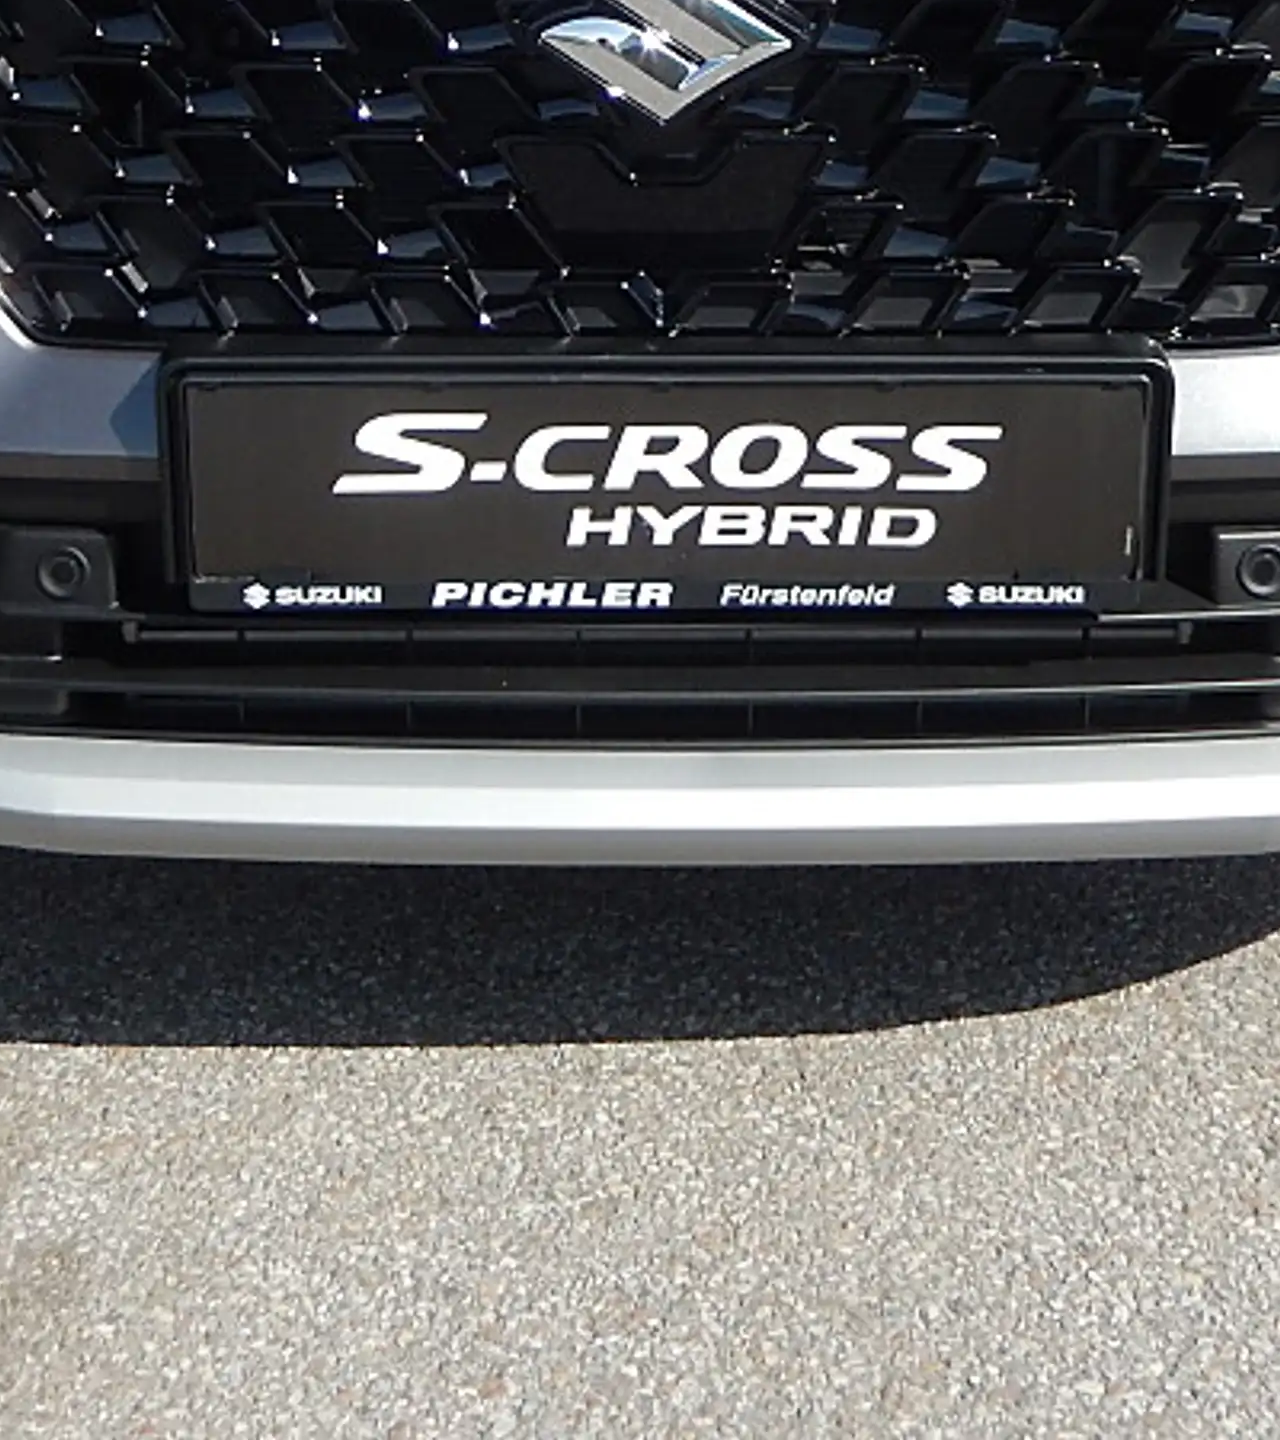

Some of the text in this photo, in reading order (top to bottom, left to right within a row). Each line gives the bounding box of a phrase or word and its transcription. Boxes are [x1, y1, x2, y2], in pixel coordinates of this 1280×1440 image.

[332, 411, 1004, 495] S-CROSS
[565, 503, 937, 548] HYBRID
[275, 581, 1085, 608] SUZUKI PICHLER Fürstenfeld SUZUKI
